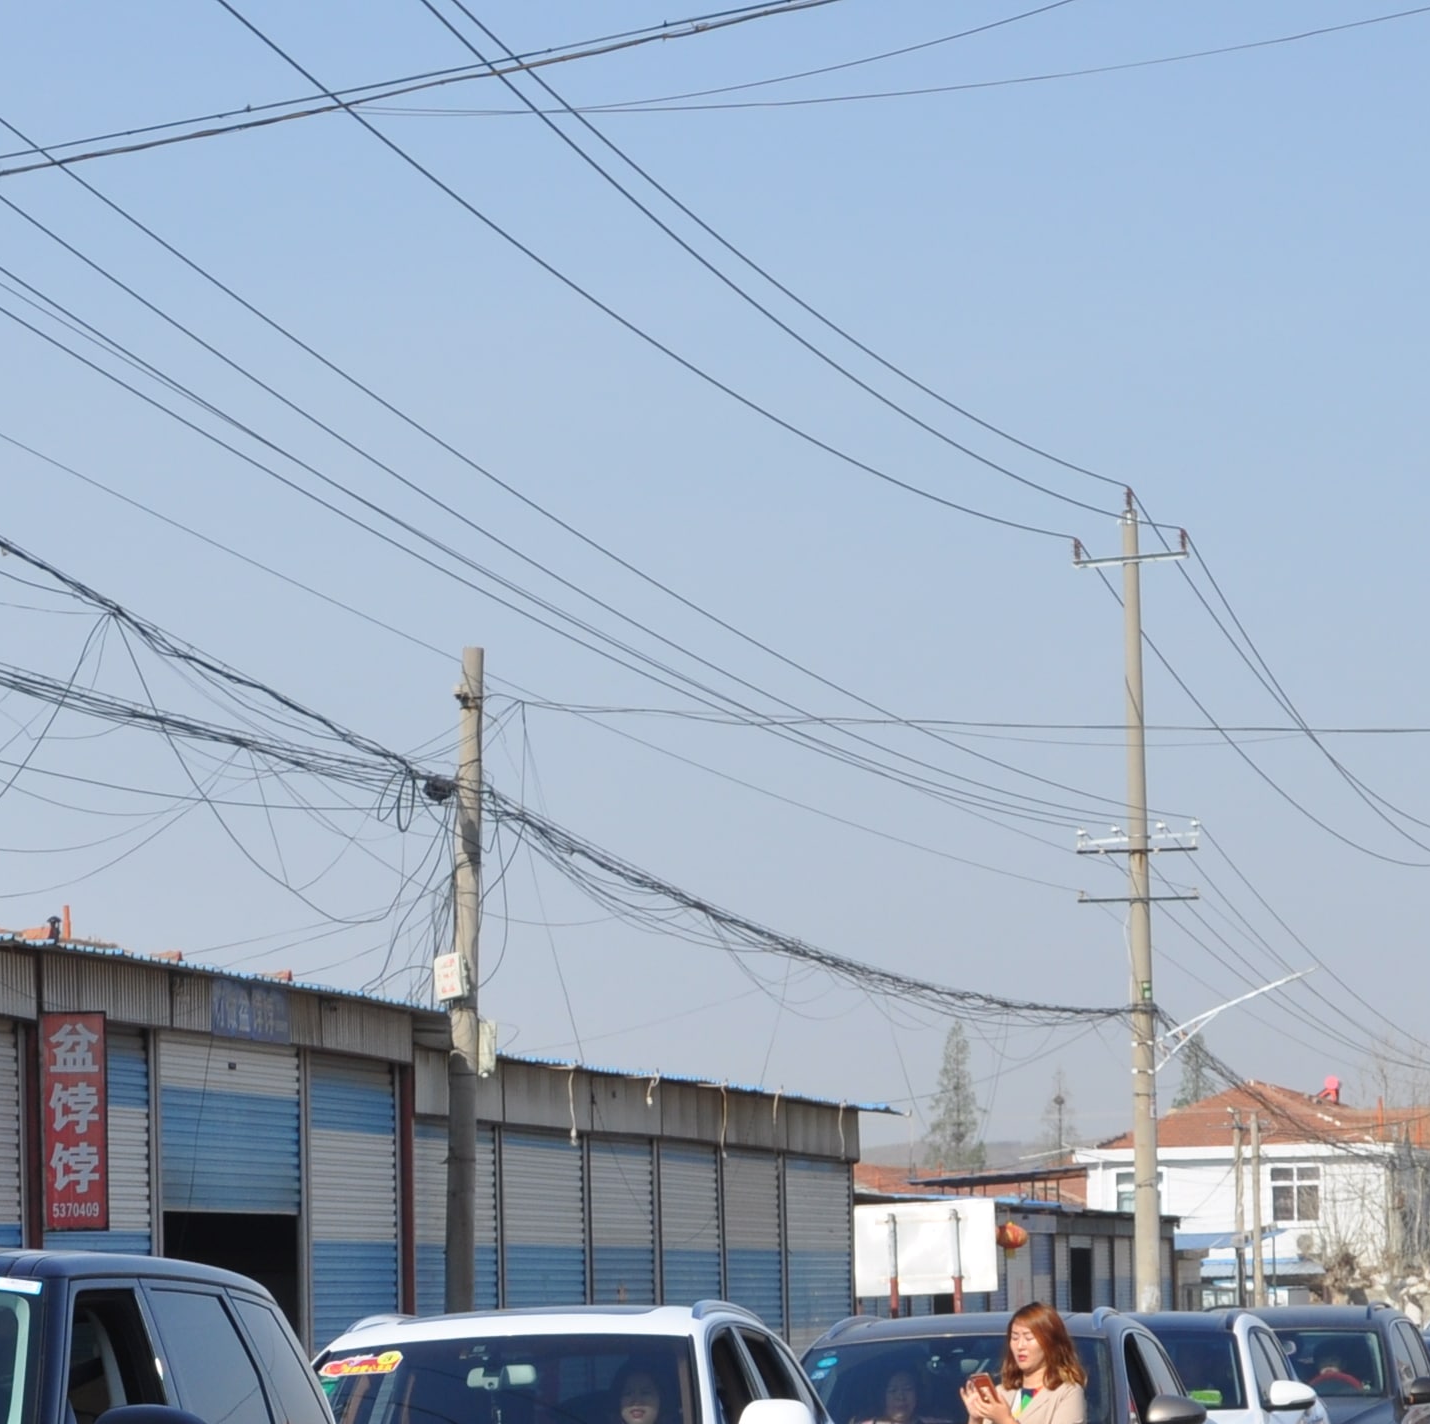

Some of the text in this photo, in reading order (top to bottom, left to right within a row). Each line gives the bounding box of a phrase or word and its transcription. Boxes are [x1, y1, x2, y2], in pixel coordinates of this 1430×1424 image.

[49, 1023, 99, 1194] 盆饽饽
[52, 1203, 99, 1218] 5370409
